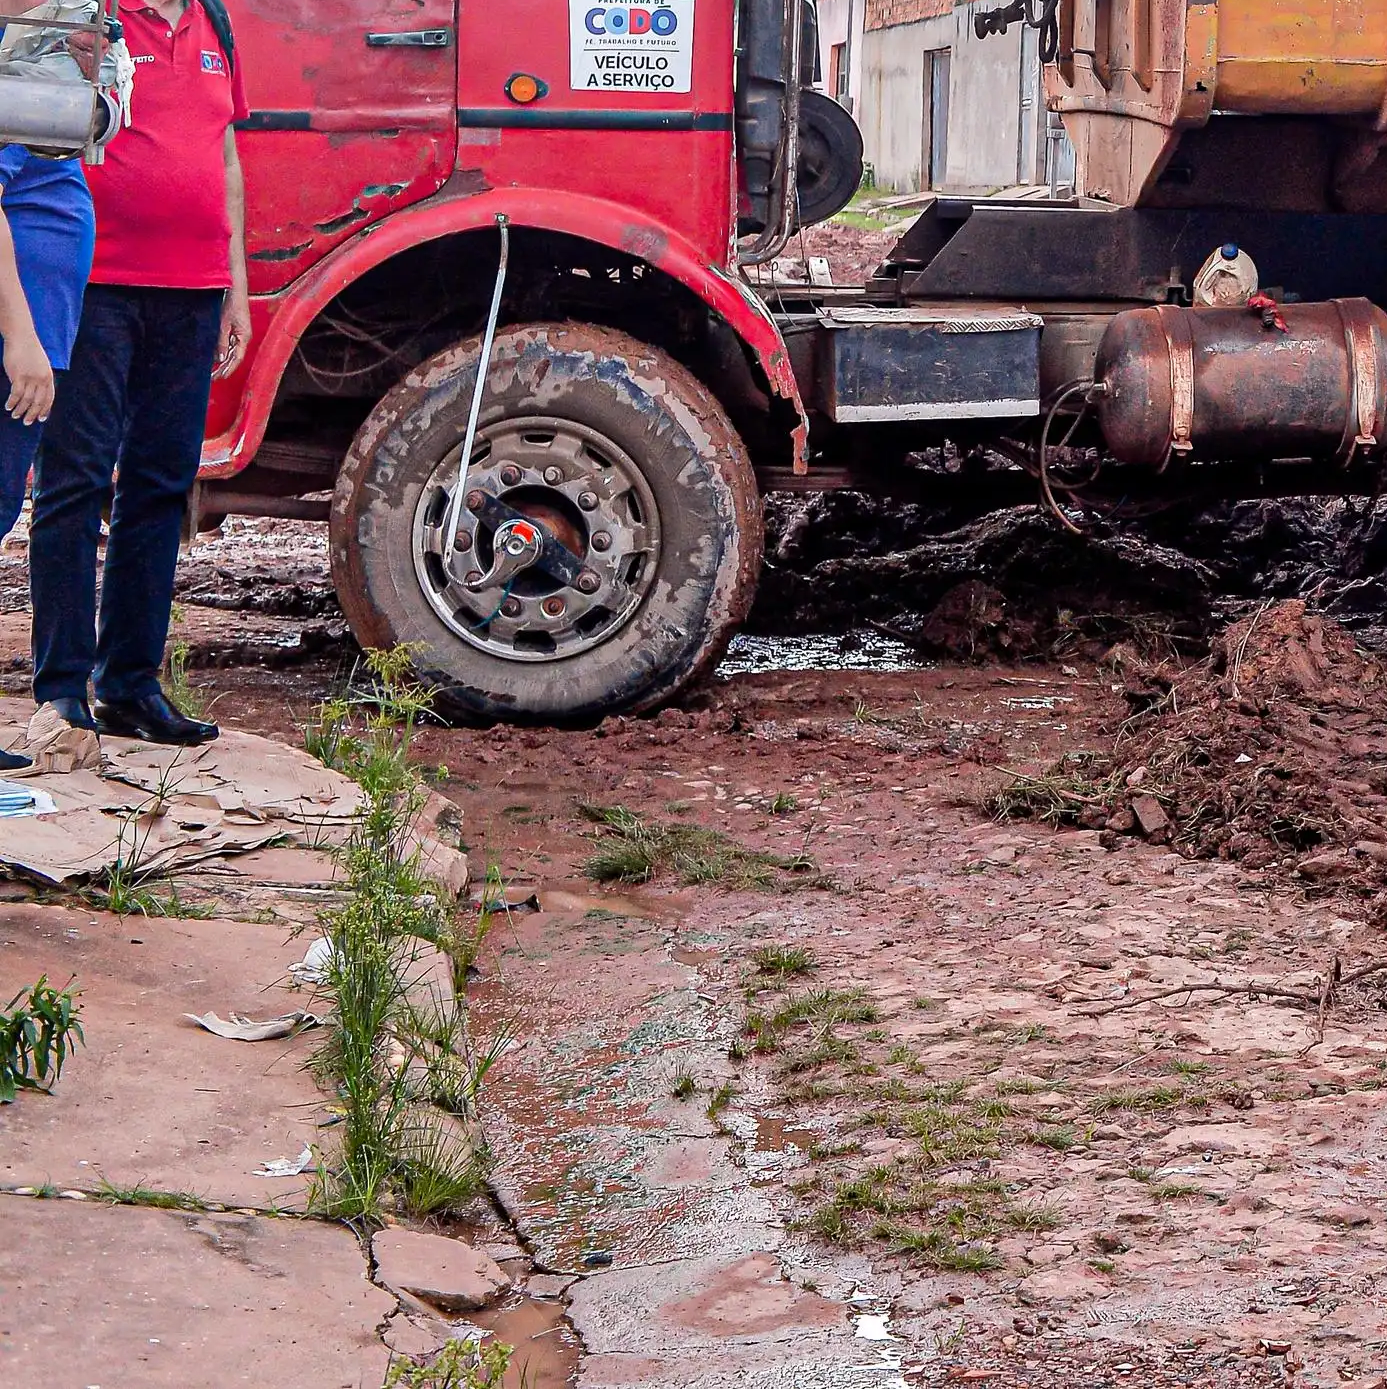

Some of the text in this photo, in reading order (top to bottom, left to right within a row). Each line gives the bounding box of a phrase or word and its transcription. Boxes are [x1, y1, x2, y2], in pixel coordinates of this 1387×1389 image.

[584, 4, 678, 36] CODÓ
[594, 52, 669, 70] VEÍCULO
[586, 73, 674, 91] A SERVIÇO
